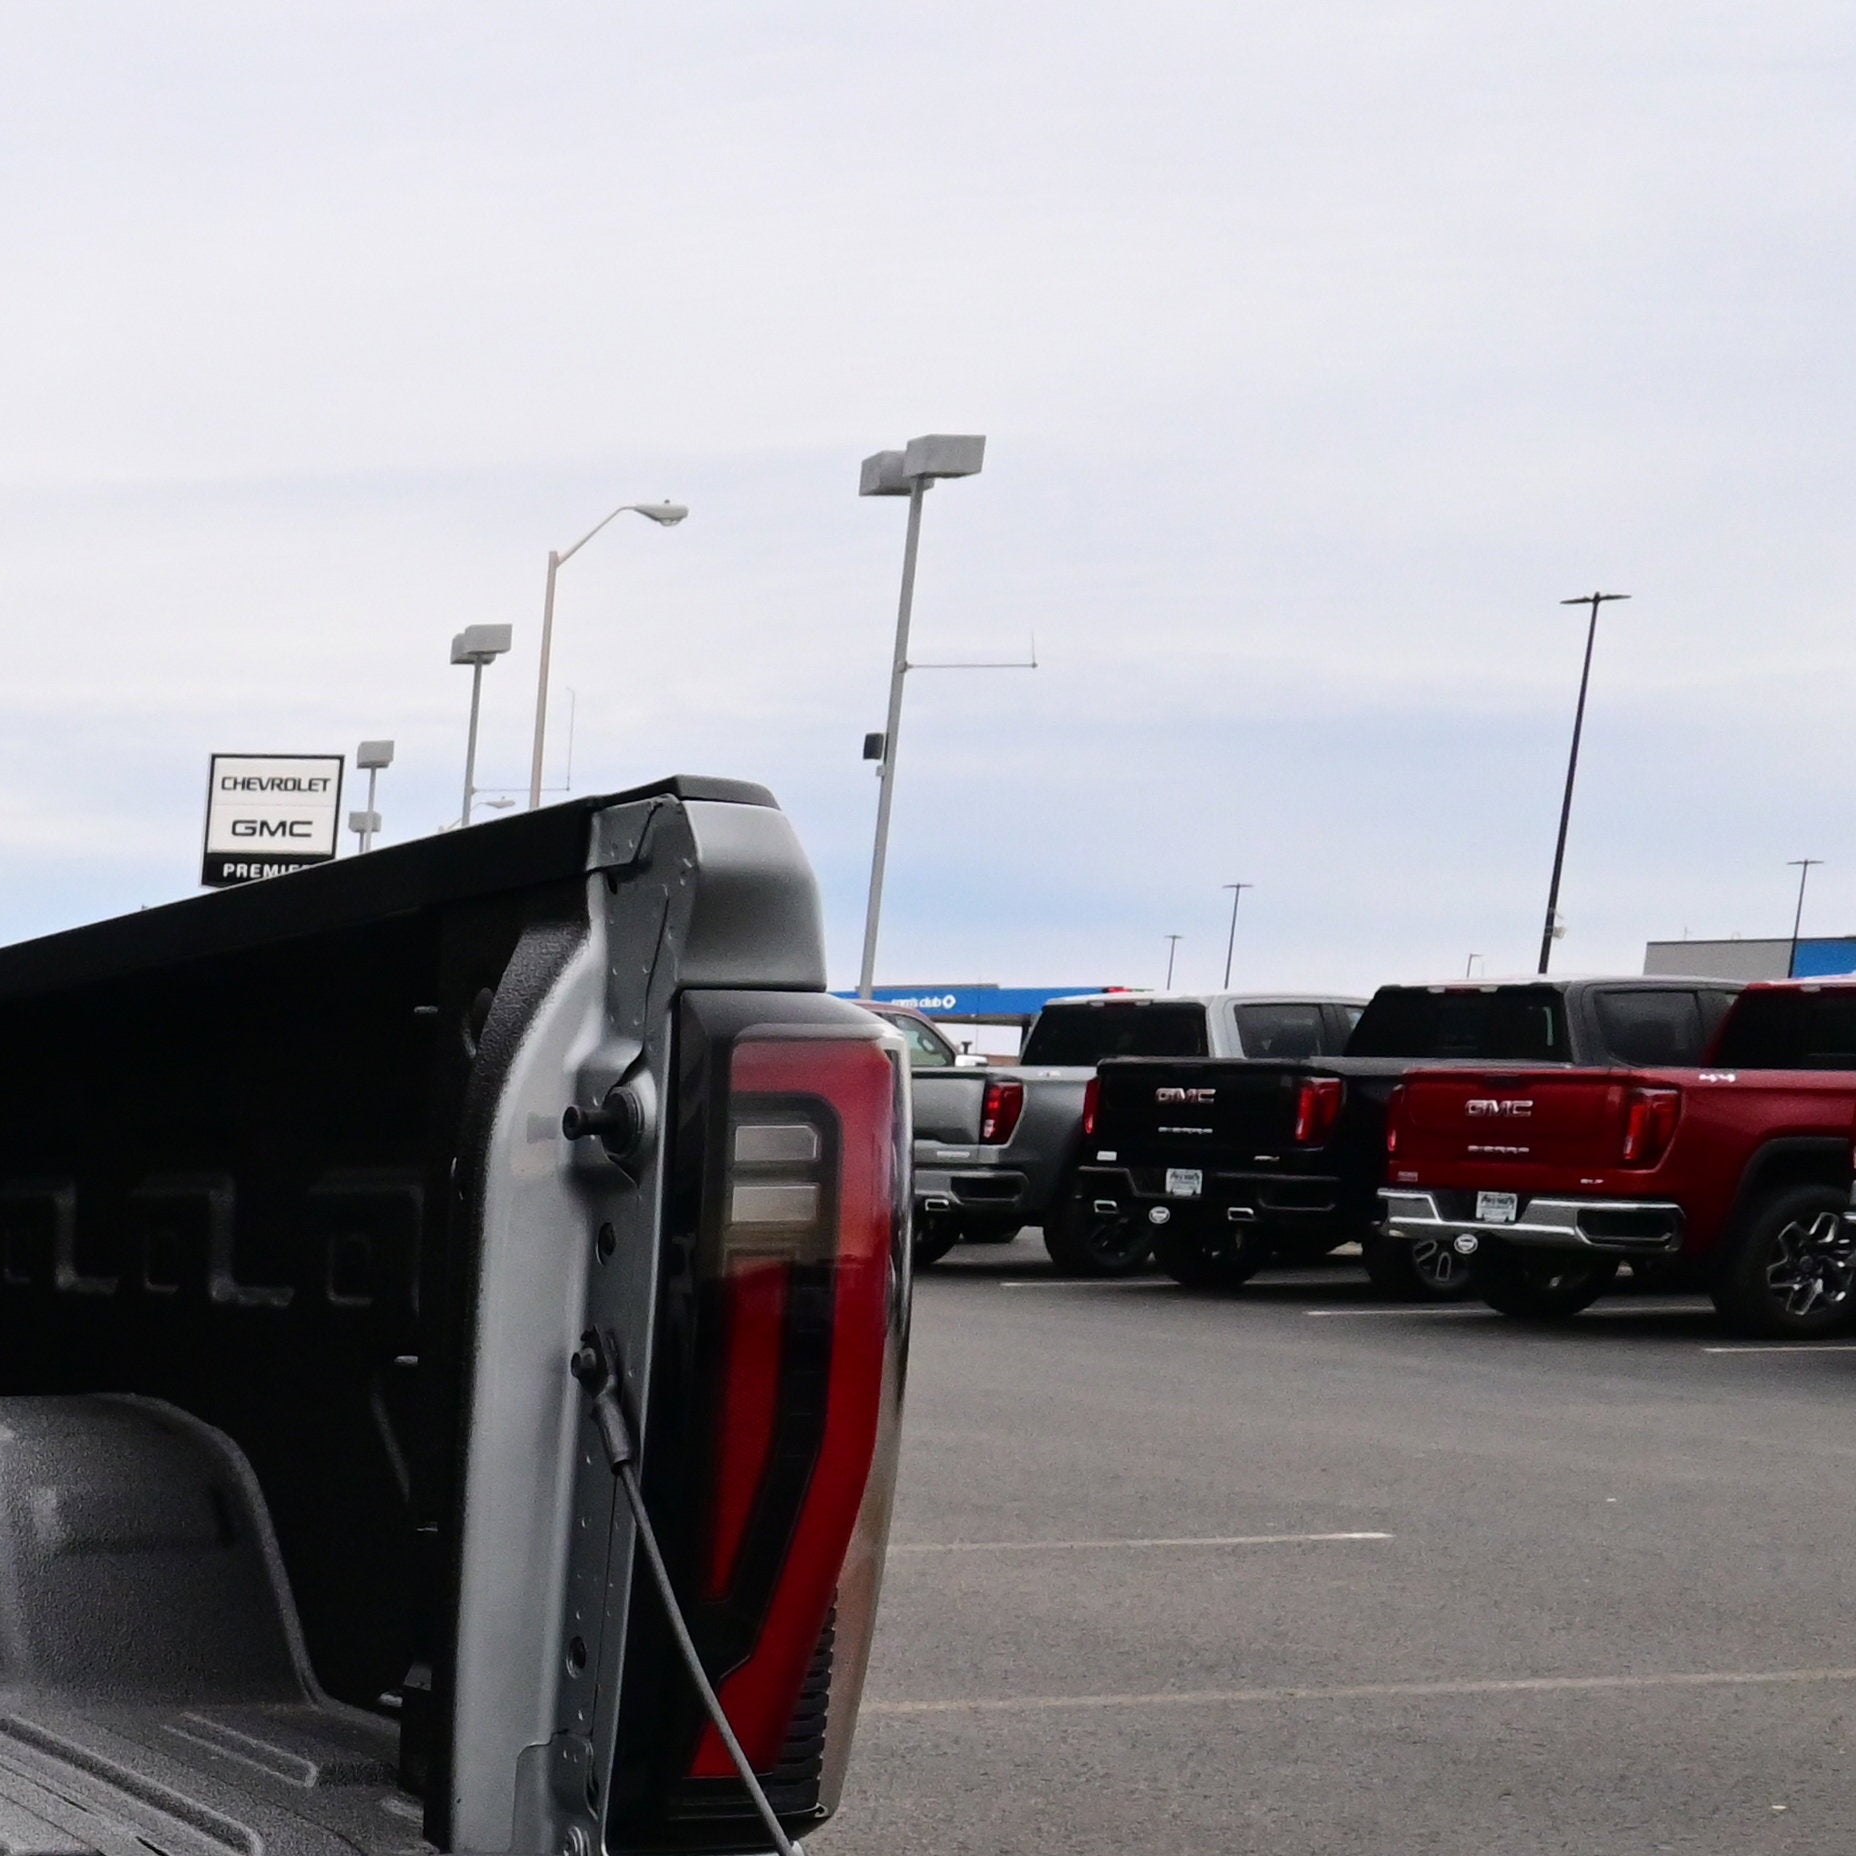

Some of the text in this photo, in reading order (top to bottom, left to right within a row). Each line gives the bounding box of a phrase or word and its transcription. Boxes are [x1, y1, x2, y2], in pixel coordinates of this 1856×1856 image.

[220, 776, 331, 793] CHEVROLET
[231, 818, 313, 838] GMC
[223, 863, 309, 879] PREMI
[1154, 1087, 1217, 1104] GMC
[1464, 1099, 1534, 1117] GMC
